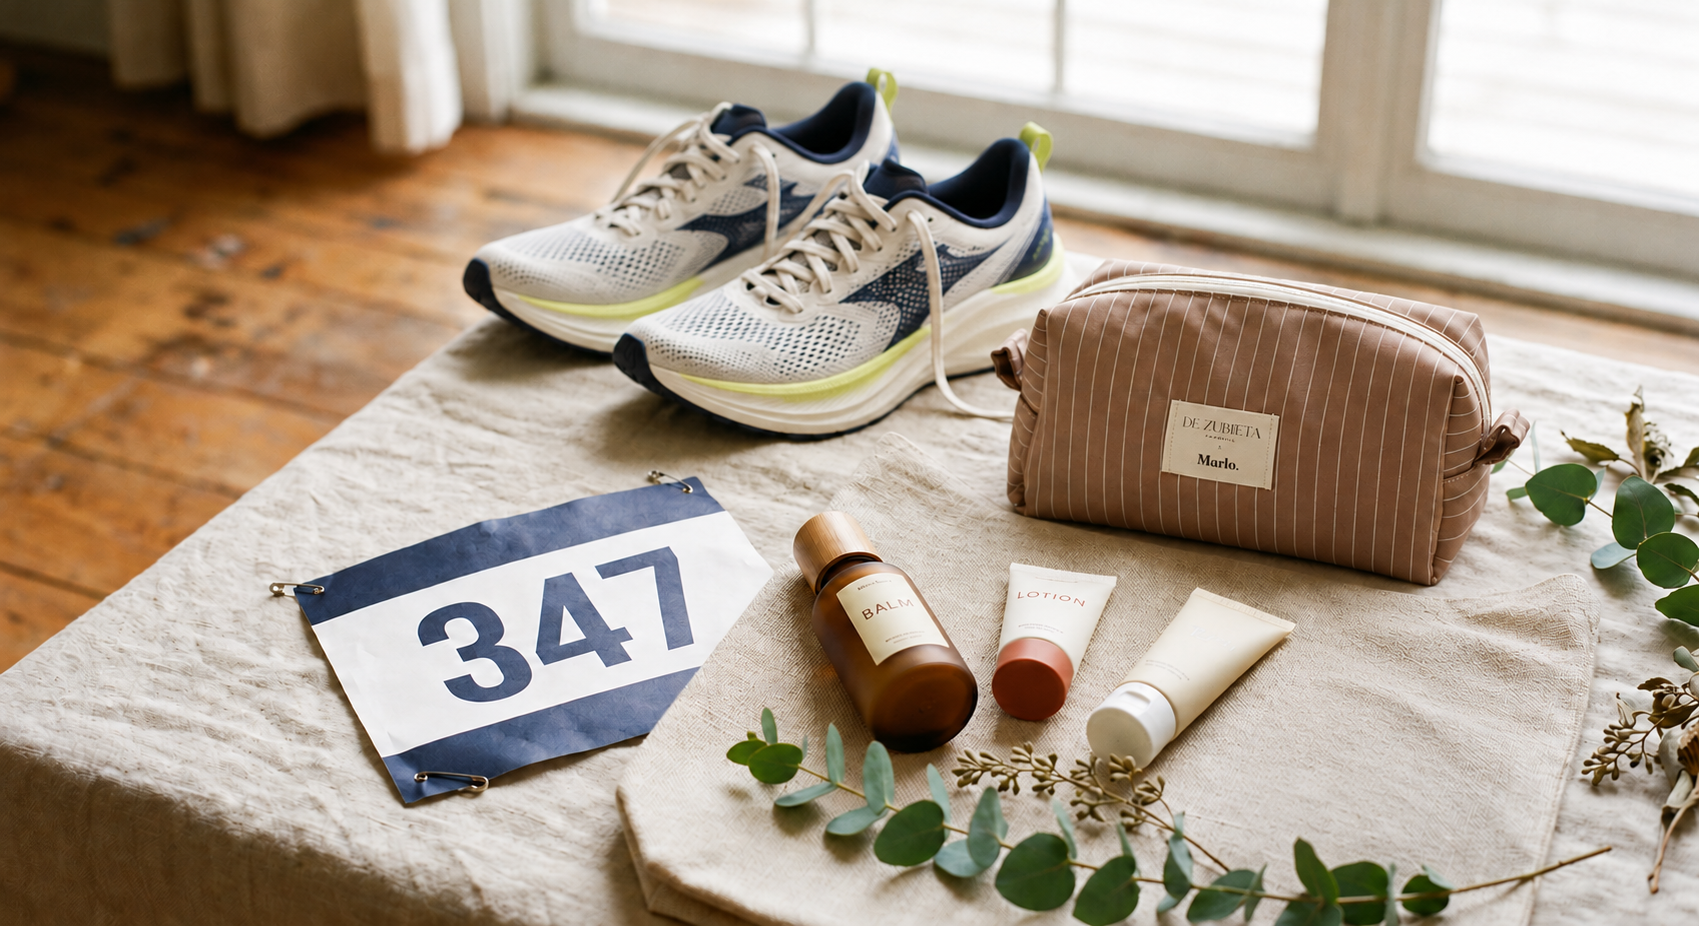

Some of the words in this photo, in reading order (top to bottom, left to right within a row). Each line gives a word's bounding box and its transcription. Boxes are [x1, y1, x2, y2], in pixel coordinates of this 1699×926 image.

[1182, 416, 1200, 430] DE
[1197, 453, 1239, 471] Marlo.
[1017, 591, 1086, 608] LOTION
[861, 599, 915, 621] BALM
[417, 546, 695, 704] 347
